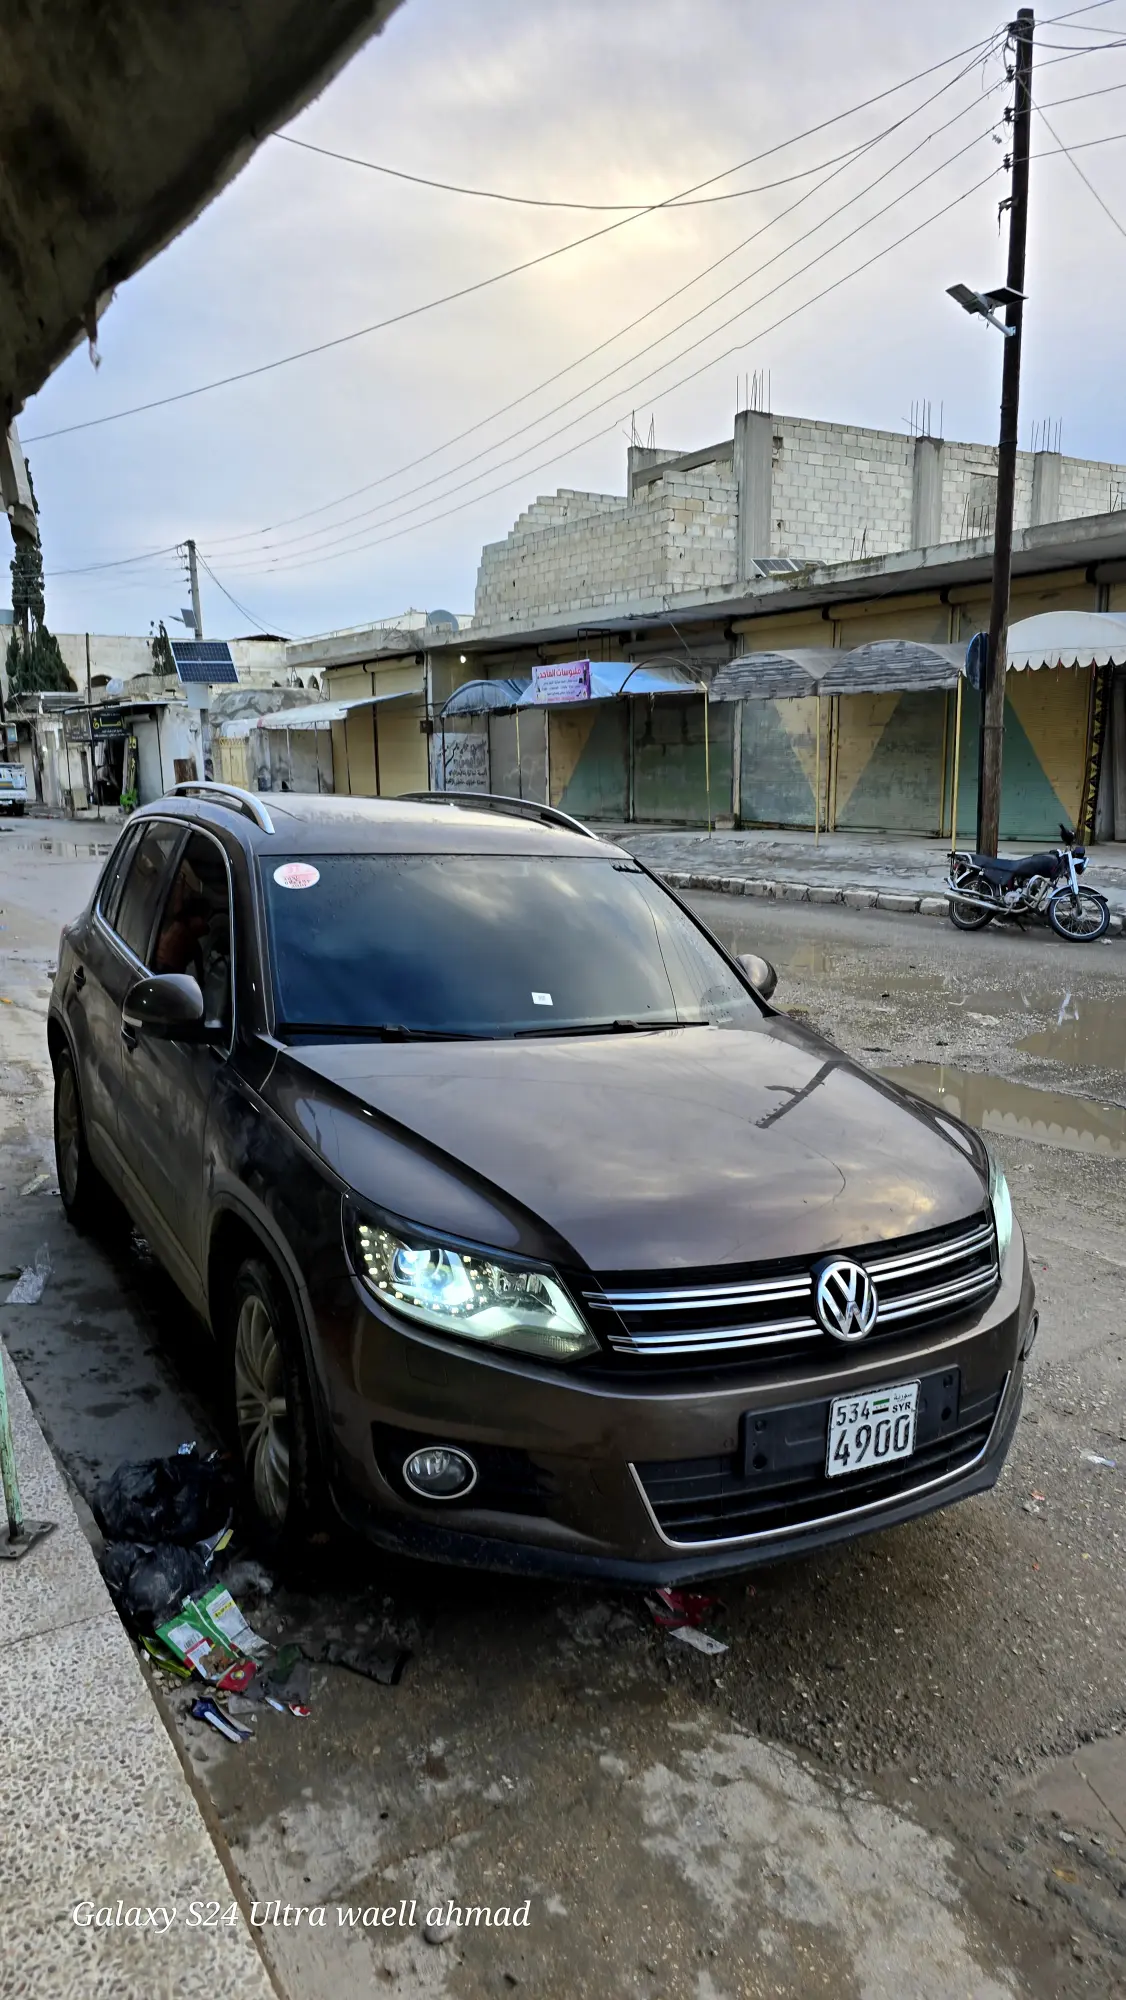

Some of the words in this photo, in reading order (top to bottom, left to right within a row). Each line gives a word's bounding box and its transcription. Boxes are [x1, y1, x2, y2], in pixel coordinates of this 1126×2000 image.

[539, 669, 555, 680] الماجد
[556, 667, 581, 679] ملبوسات
[893, 1393, 913, 1402] سورية
[836, 1400, 870, 1426] 534
[892, 1401, 911, 1414] SYR
[834, 1414, 910, 1467] 4900
